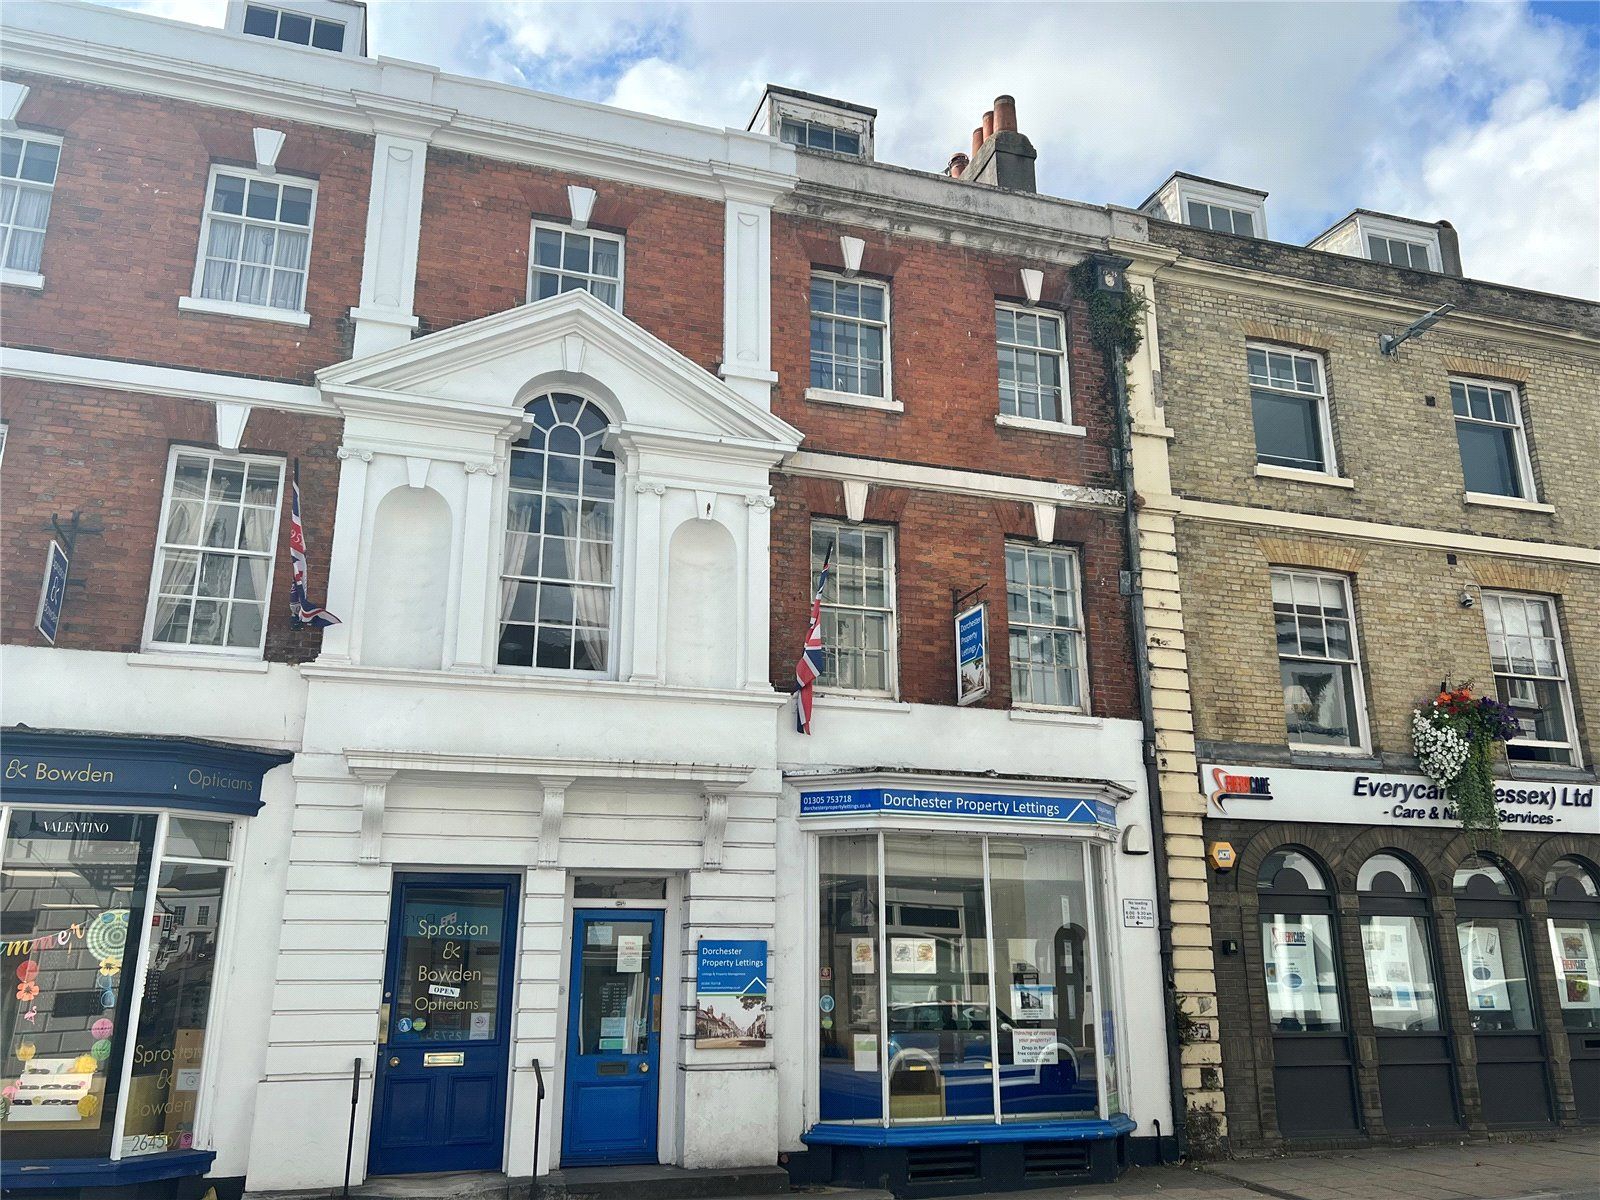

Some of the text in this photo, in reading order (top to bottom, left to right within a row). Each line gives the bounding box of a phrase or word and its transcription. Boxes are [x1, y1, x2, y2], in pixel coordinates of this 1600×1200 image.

[961, 617, 982, 631] Dorchester
[961, 631, 976, 645] Property
[5, 758, 114, 783] & Bowden
[188, 769, 253, 791] Opticians
[803, 795, 852, 805] 01305 753718
[1561, 786, 1593, 807] Ltd
[883, 793, 1060, 817] Dorchester Property Lettings
[1393, 804, 1426, 819] Care
[1429, 806, 1439, 820] &
[1499, 810, 1553, 825] Services
[43, 820, 109, 834] VALENTINO
[418, 919, 488, 940] Sproston
[442, 941, 461, 959] &
[702, 947, 742, 955] Dorchester
[702, 959, 764, 968] Property Lettings
[418, 963, 481, 982] Bowden
[433, 986, 456, 996] OPEN
[414, 996, 479, 1013] Opticians
